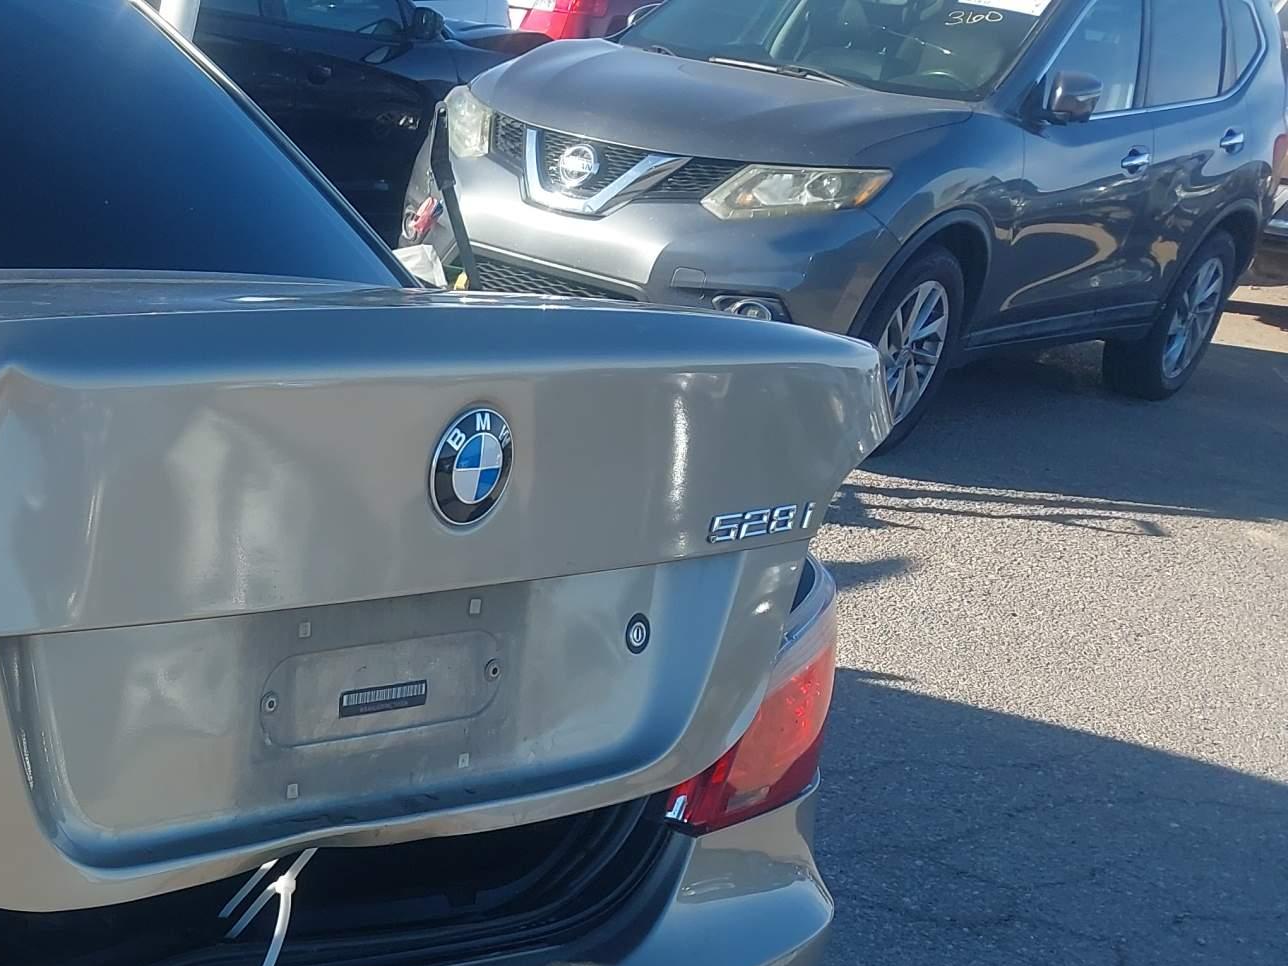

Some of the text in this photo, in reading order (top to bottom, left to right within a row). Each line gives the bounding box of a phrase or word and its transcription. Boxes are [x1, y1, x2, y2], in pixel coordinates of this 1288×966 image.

[945, 10, 1003, 26] 360
[446, 412, 512, 451] BMW
[709, 502, 816, 543] 528i
